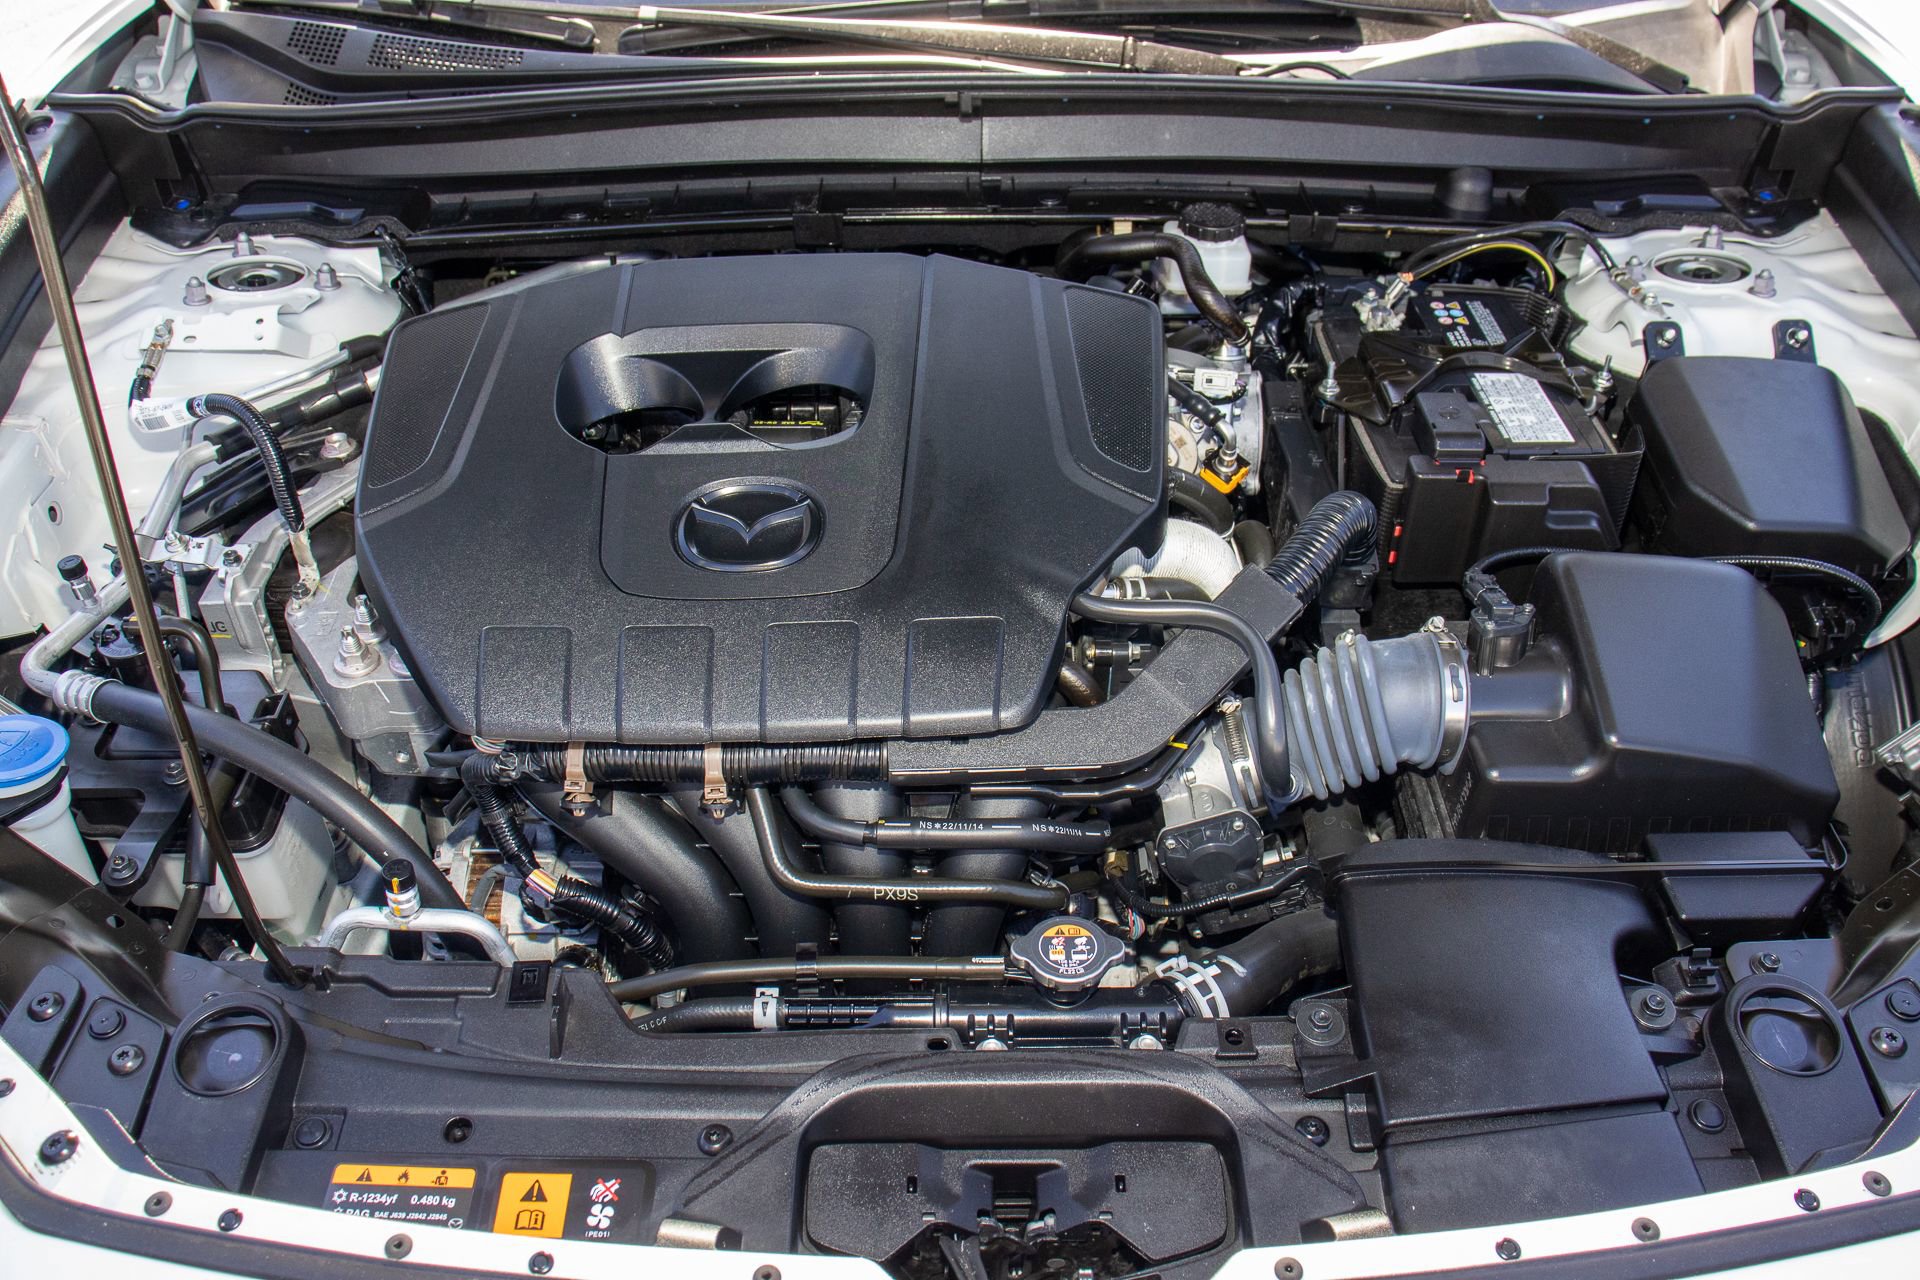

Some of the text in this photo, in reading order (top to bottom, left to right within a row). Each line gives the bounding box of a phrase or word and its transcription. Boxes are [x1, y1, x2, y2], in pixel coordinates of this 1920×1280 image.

[873, 887, 919, 901] PX9S
[349, 1192, 456, 1208] R-1234yf 0.480 kg
